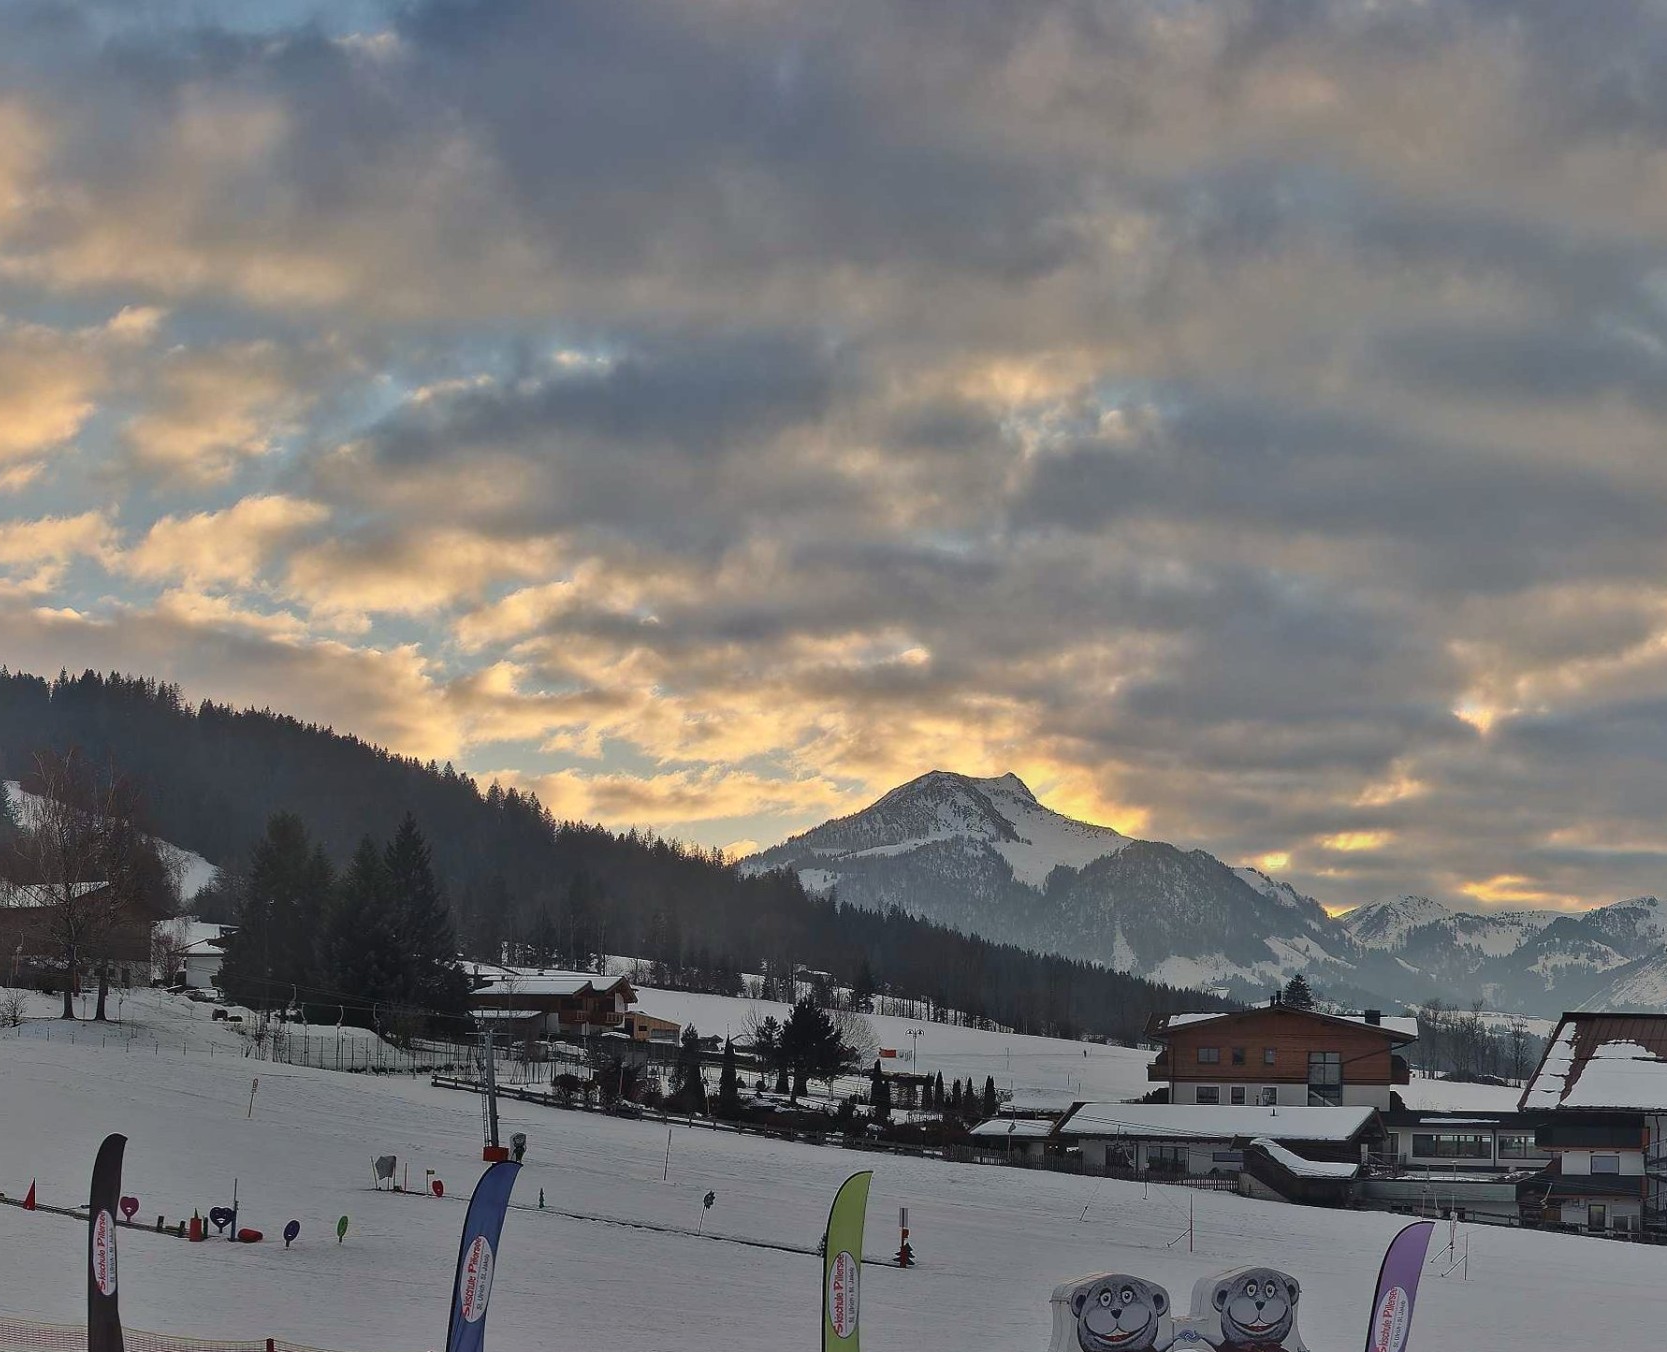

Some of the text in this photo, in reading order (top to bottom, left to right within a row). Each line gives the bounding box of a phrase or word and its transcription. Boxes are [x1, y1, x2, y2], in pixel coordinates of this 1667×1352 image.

[461, 1235, 482, 1318] Skischule Pillersee
[833, 1253, 845, 1334] Skischule Pillersee
[1383, 1287, 1398, 1318] Pillersee
